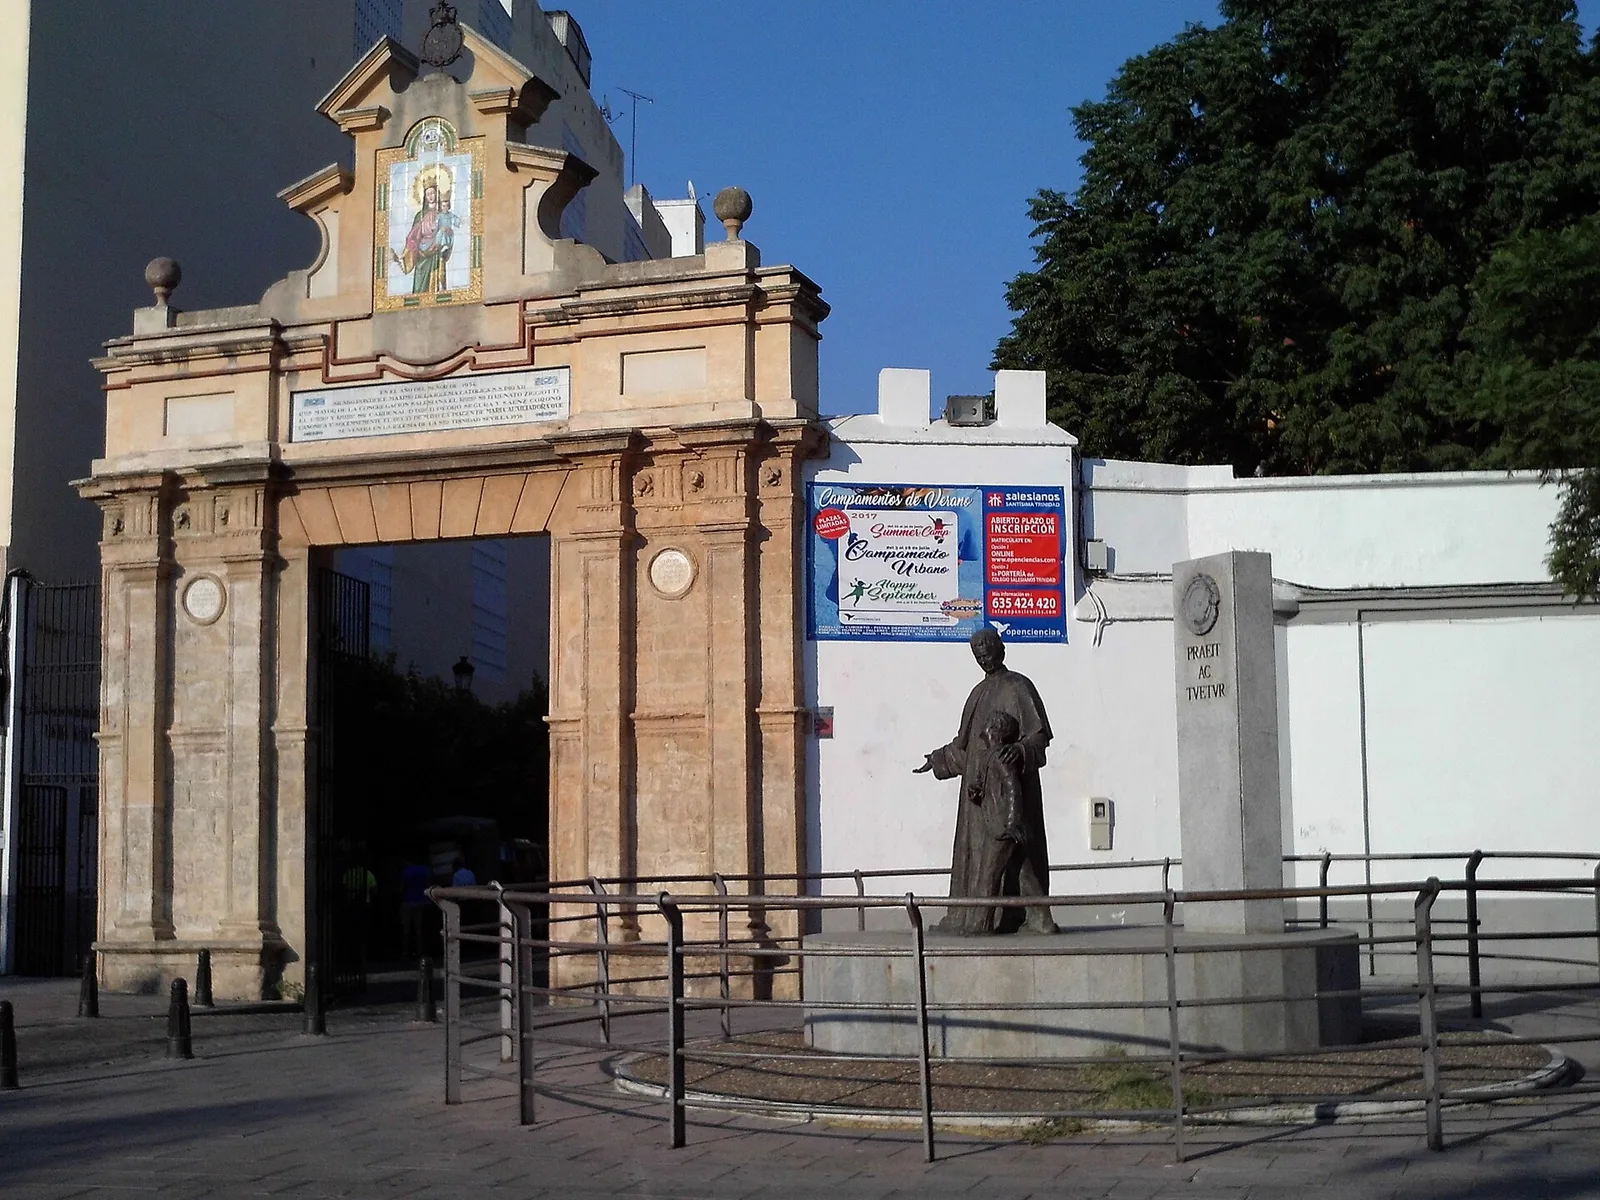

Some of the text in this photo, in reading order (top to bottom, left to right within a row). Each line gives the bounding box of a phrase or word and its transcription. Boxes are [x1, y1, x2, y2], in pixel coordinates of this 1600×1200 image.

[819, 487, 973, 510] Campamentos de Verano
[1006, 492, 1060, 501] salesianos
[819, 514, 841, 524] PLAZAS
[851, 512, 878, 520] 2017
[816, 518, 847, 530] LIMITADAS
[991, 524, 1055, 534] INSCRIPCIÓN
[870, 523, 950, 539] Summer Camp
[845, 539, 949, 563] Campamento
[891, 559, 950, 577] Urbano
[875, 578, 918, 590] Happy
[867, 588, 937, 602] September
[992, 597, 1012, 609] 635
[1014, 597, 1034, 609] 424
[1036, 598, 1056, 609] 420
[1006, 628, 1060, 636] openciencias
[1198, 665, 1211, 680] AC
[1185, 683, 1226, 701] TVETVR
